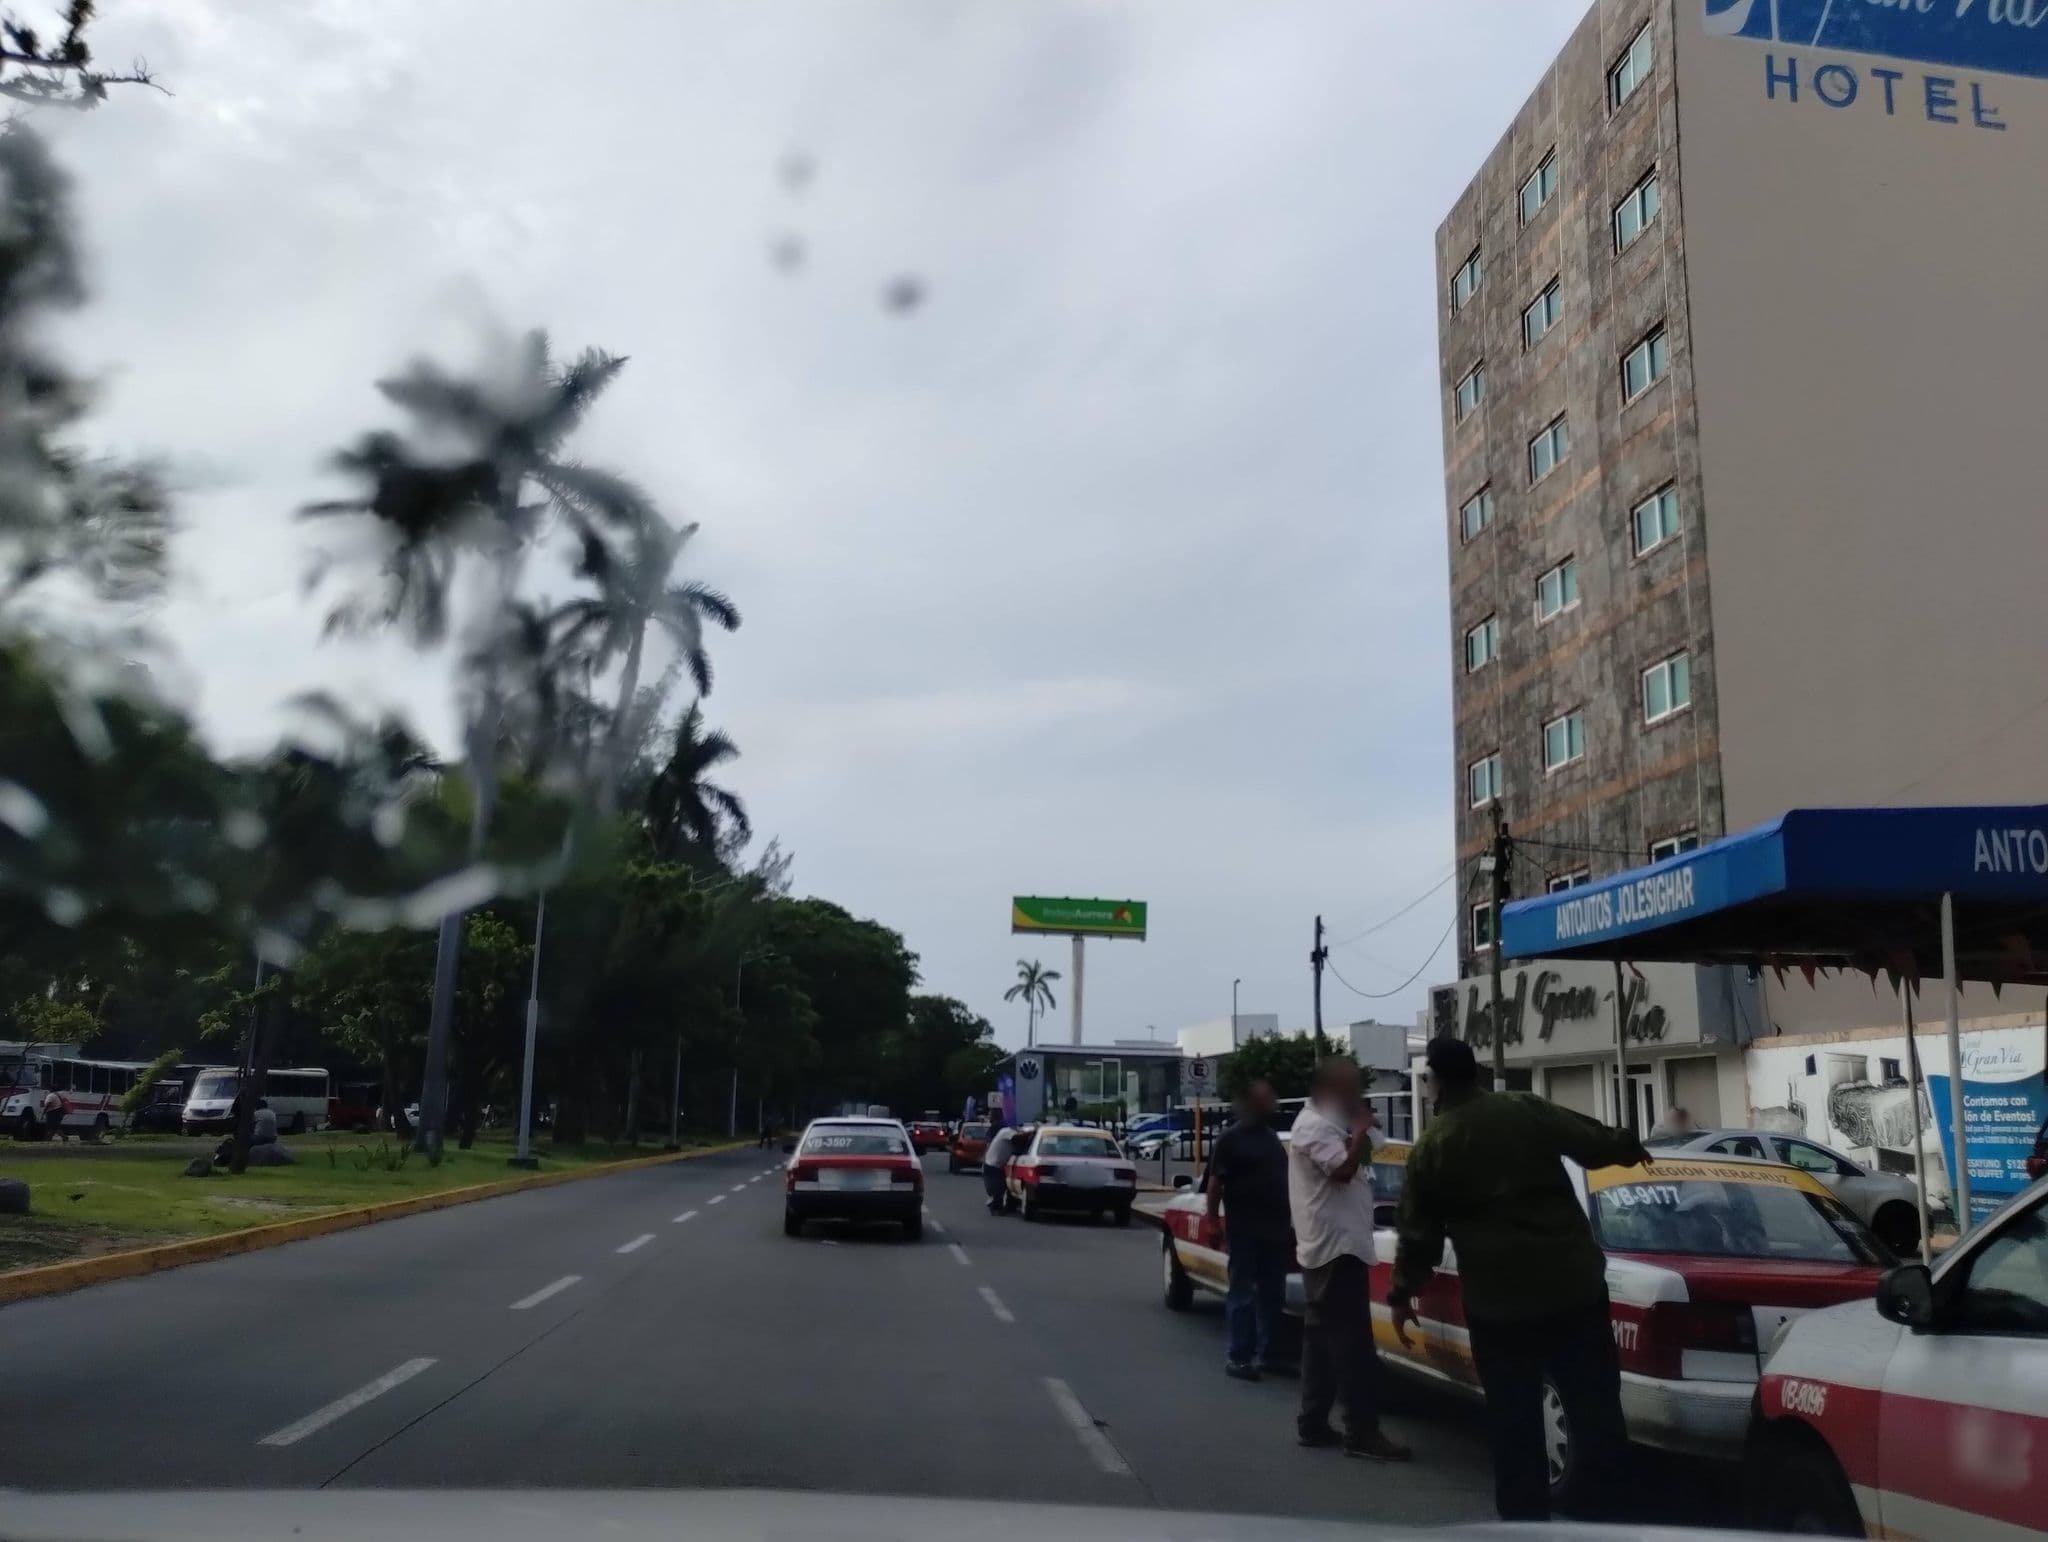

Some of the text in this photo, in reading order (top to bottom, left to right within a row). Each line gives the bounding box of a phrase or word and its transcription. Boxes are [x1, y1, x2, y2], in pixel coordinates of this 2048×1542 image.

[1765, 54, 2006, 131] HOTEL
[1974, 828, 2048, 874] ANTO
[1556, 866, 1694, 940] ANTOJITOS JOLESIGHAR
[1963, 1095, 2028, 1107] Contamos con
[1980, 1110, 1992, 1121] de
[1994, 1110, 2036, 1122] Eventos!
[1708, 1168, 1793, 1184] VERACRUZ
[1603, 1185, 1681, 1207] VB-9177
